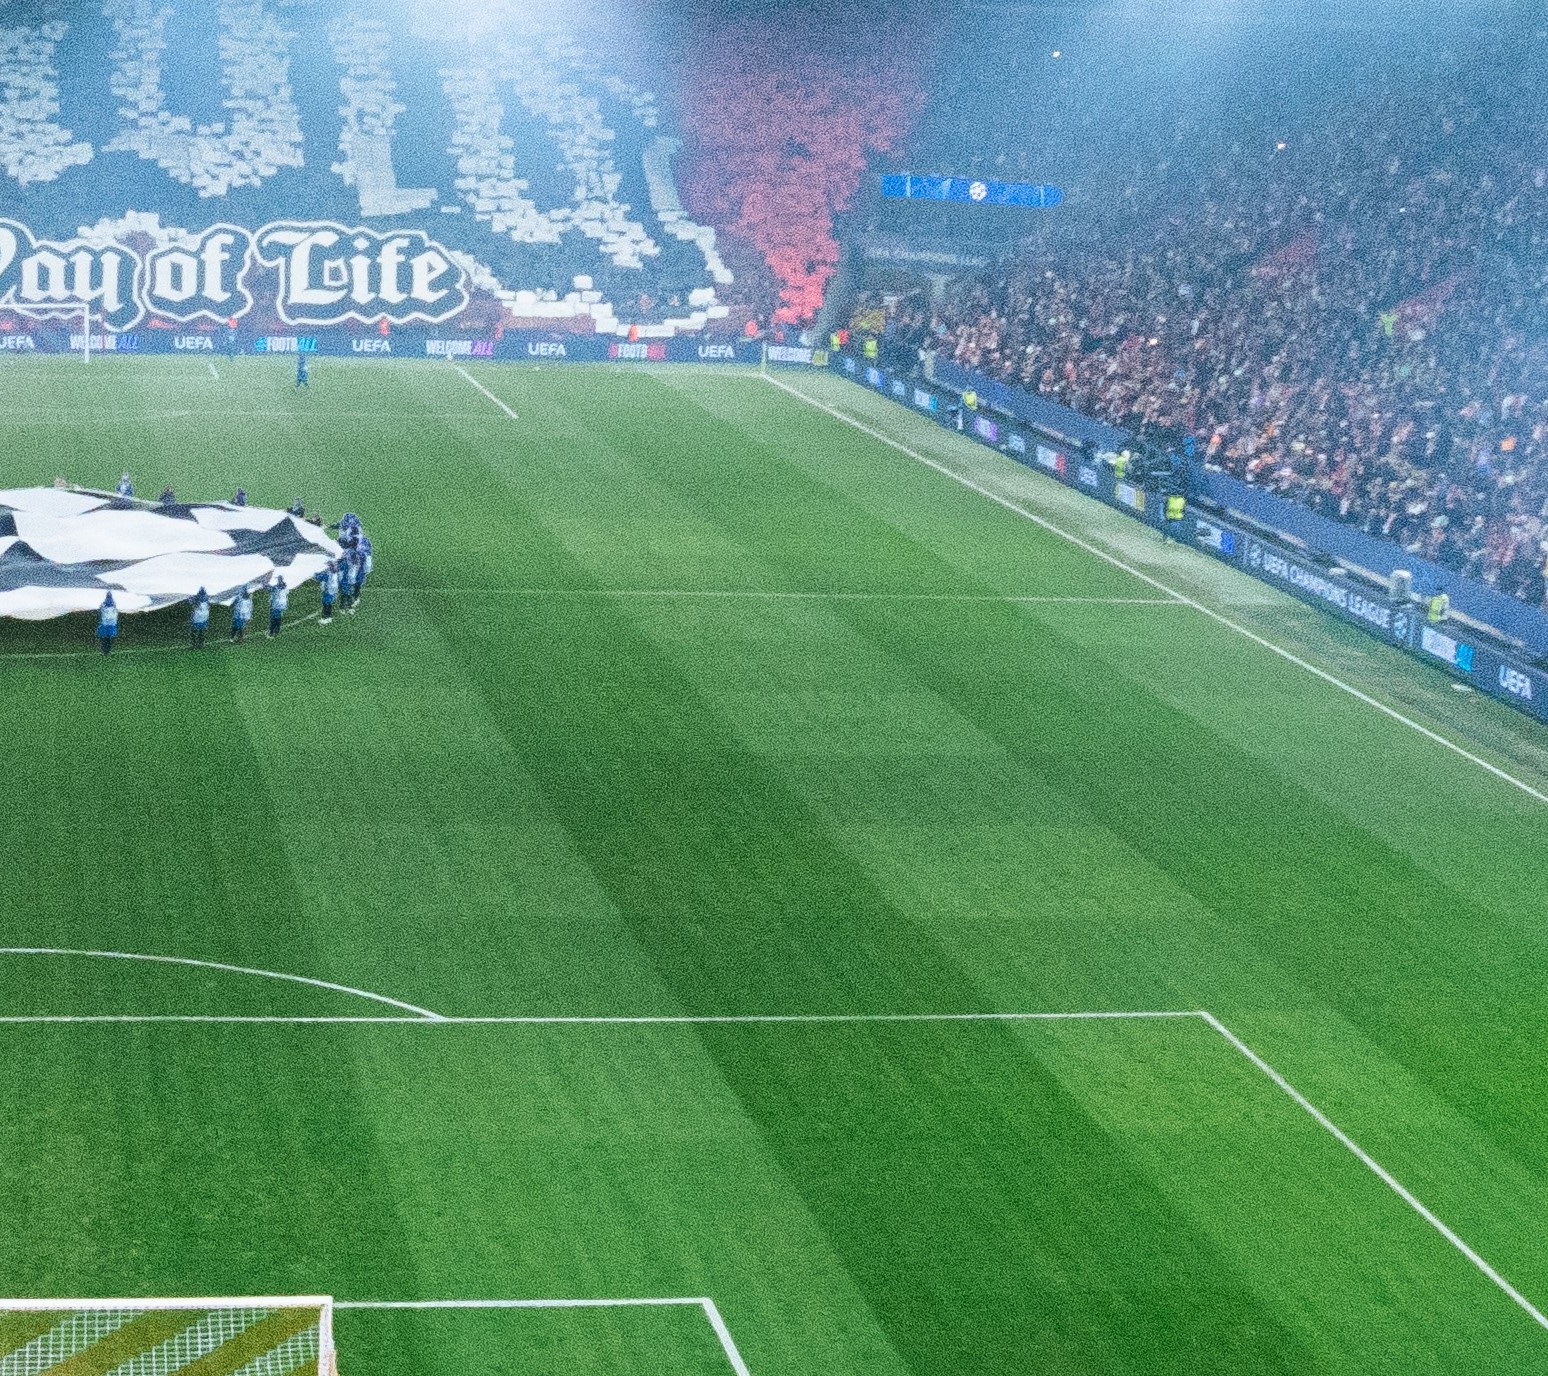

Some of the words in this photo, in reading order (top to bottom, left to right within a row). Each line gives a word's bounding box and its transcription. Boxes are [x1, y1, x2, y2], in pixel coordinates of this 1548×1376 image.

[151, 231, 236, 305] of
[261, 228, 455, 307] Life
[174, 336, 214, 350] UEFA
[352, 339, 391, 353] UEFA
[528, 342, 567, 356] UEFA
[698, 345, 735, 358] UEFA
